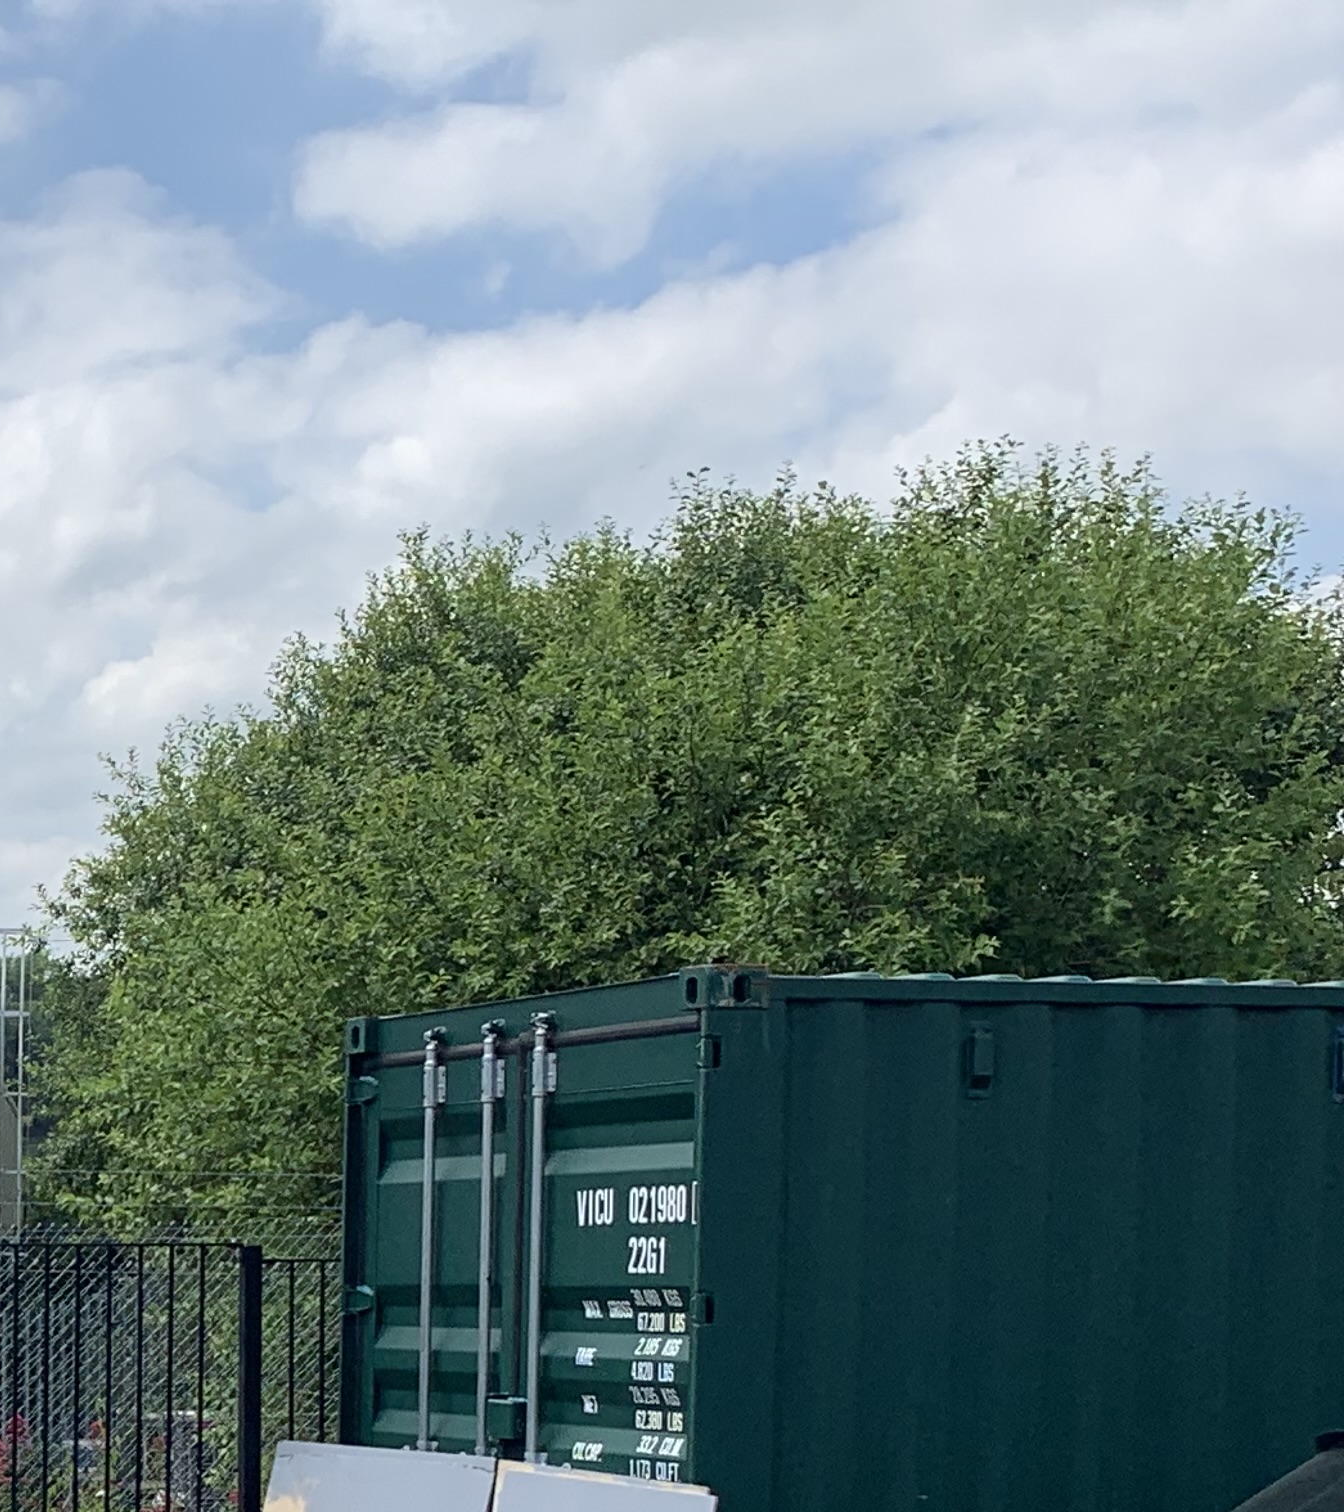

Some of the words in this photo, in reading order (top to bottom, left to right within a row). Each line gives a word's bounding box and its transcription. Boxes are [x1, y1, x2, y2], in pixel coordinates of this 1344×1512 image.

[576, 1187, 614, 1227] VICU
[628, 1184, 687, 1224] 021980
[627, 1236, 666, 1275] 22G1
[669, 1312, 686, 1333] LBS
[658, 1362, 675, 1382] LBS
[667, 1411, 683, 1432] LBS
